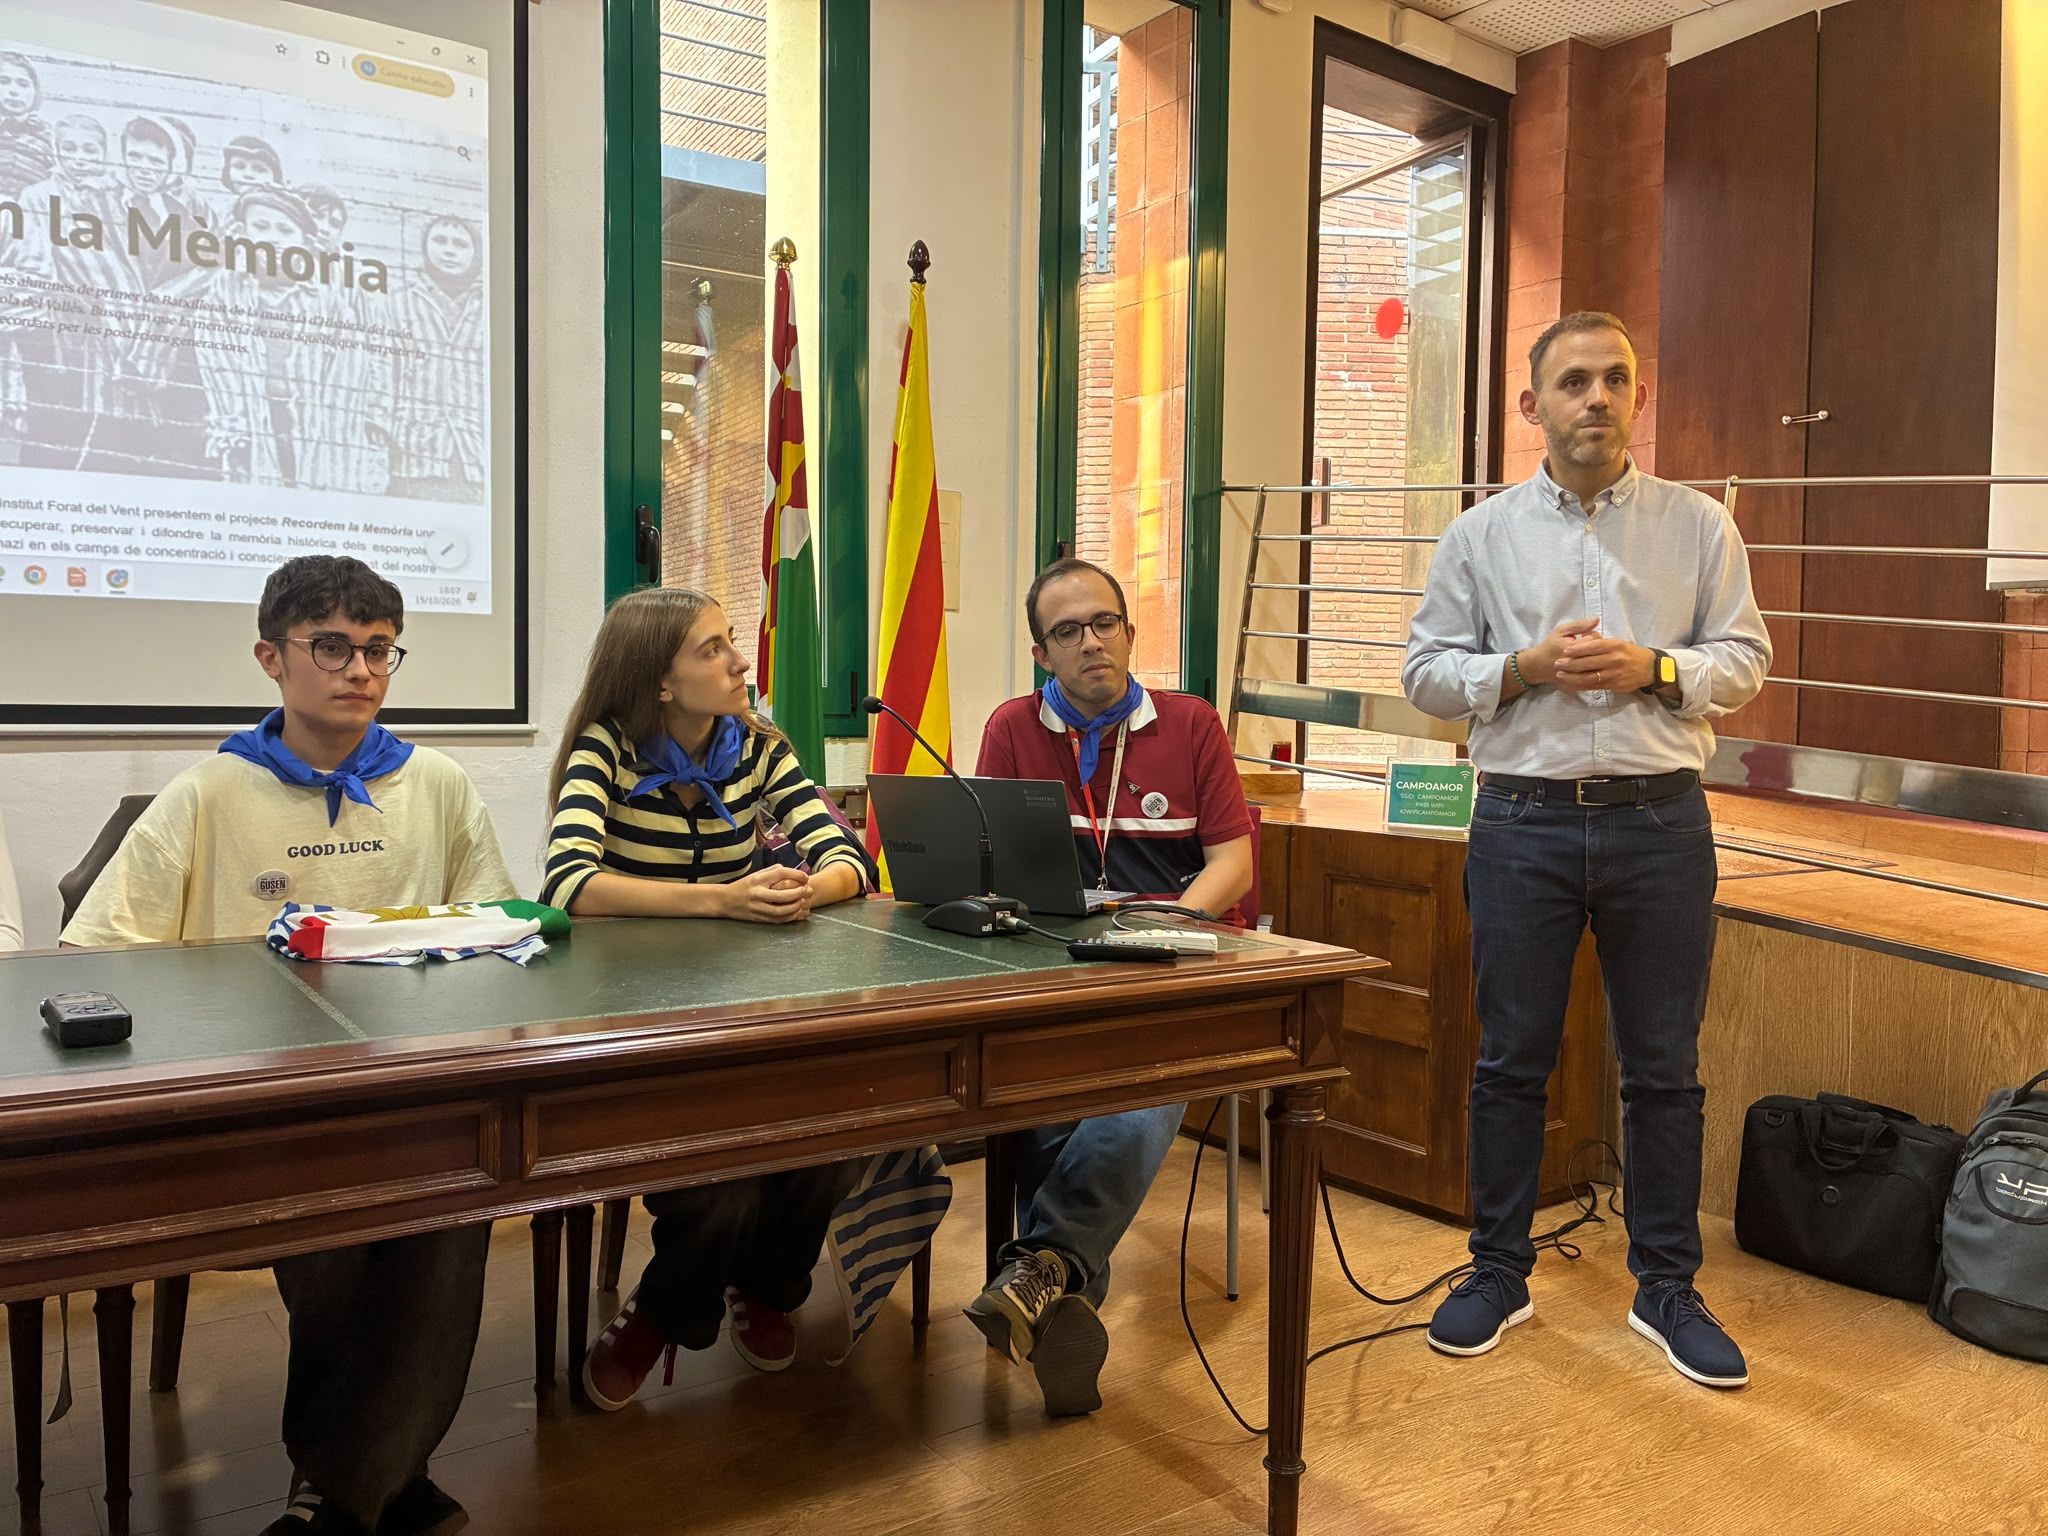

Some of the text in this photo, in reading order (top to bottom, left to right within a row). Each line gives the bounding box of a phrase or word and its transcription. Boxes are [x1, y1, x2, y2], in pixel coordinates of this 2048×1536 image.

[50, 194, 104, 251] la
[127, 206, 389, 294] Mèmoria
[17, 275, 75, 294] alumnes
[77, 284, 95, 295] de
[96, 286, 141, 302] primer
[229, 305, 246, 316] de
[22, 295, 43, 308] del
[91, 304, 151, 322] Busquem
[152, 313, 178, 329] que
[252, 327, 268, 338] de
[57, 321, 82, 334] per
[83, 323, 101, 336] les
[47, 500, 84, 514] Forat
[85, 503, 107, 515] del
[109, 504, 140, 517] Vent
[143, 507, 212, 522] presentem
[214, 511, 227, 522] el
[229, 513, 279, 527] projecte
[282, 516, 346, 532] Recordem
[348, 521, 360, 533] la
[362, 523, 414, 537] Memòria
[71, 522, 134, 537] preservar
[152, 525, 204, 540] difondre
[210, 529, 222, 541] la
[228, 530, 282, 546] memòria
[287, 535, 337, 550] històrica
[343, 539, 367, 552] dels
[372, 541, 428, 557] espanyols
[28, 541, 46, 551] en
[51, 540, 71, 552] els
[75, 542, 120, 557] camps
[124, 543, 141, 556] de
[145, 545, 227, 561] concentració
[382, 560, 399, 573] del
[402, 563, 437, 574] nostre
[1395, 781, 1464, 792] CAMPOAMOR
[1417, 793, 1459, 801] CAMPOAMOR
[287, 839, 385, 858] GOOD LUCK
[260, 879, 286, 891] GUSEN
